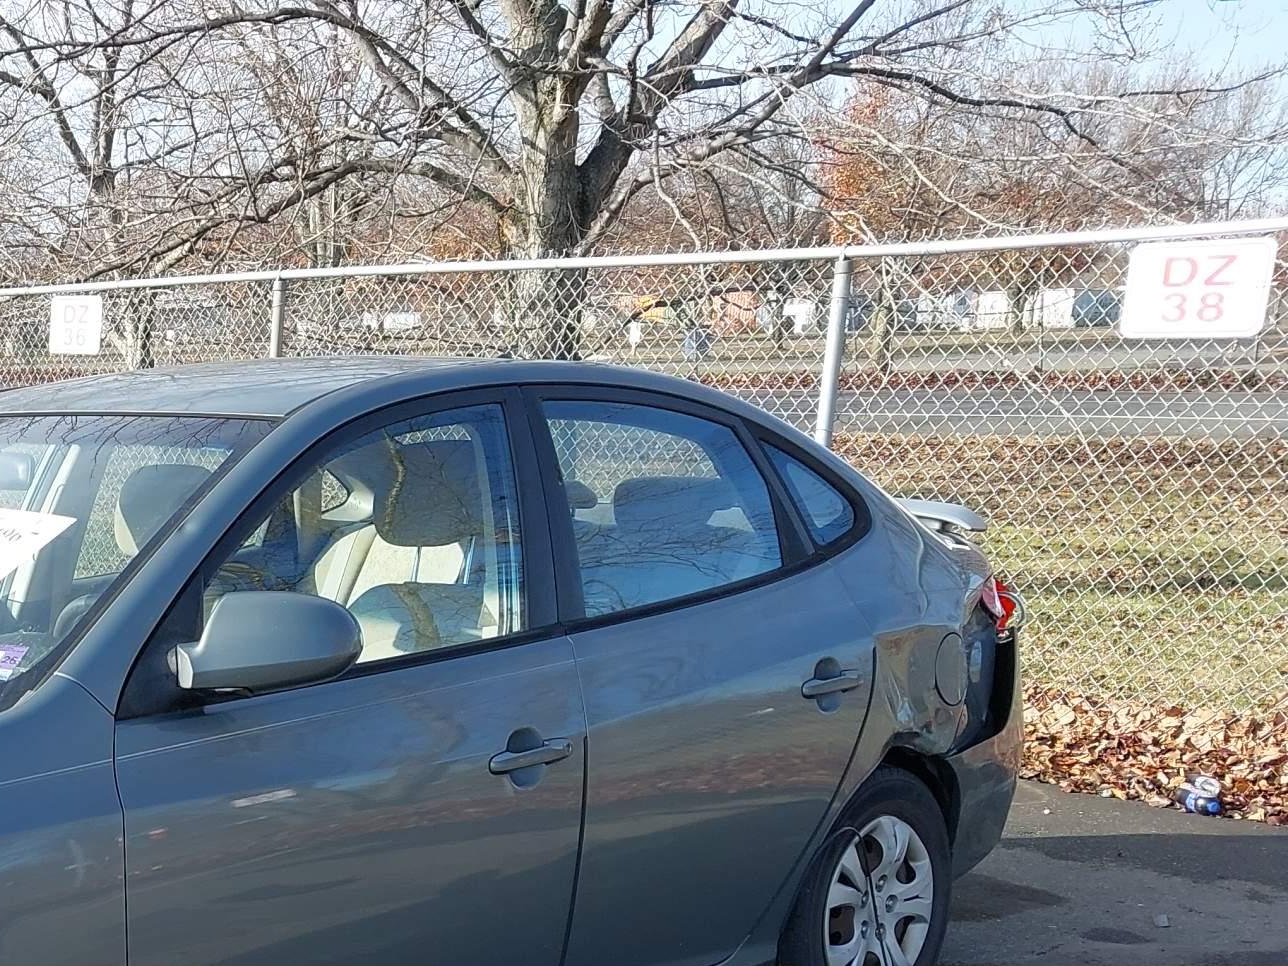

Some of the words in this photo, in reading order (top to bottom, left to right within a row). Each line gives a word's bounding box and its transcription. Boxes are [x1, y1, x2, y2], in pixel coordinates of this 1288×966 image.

[1163, 254, 1239, 288] DZ
[63, 304, 89, 324] DZ
[1161, 291, 1225, 322] 38
[63, 327, 87, 346] 36
[0, 655, 20, 666] 26
